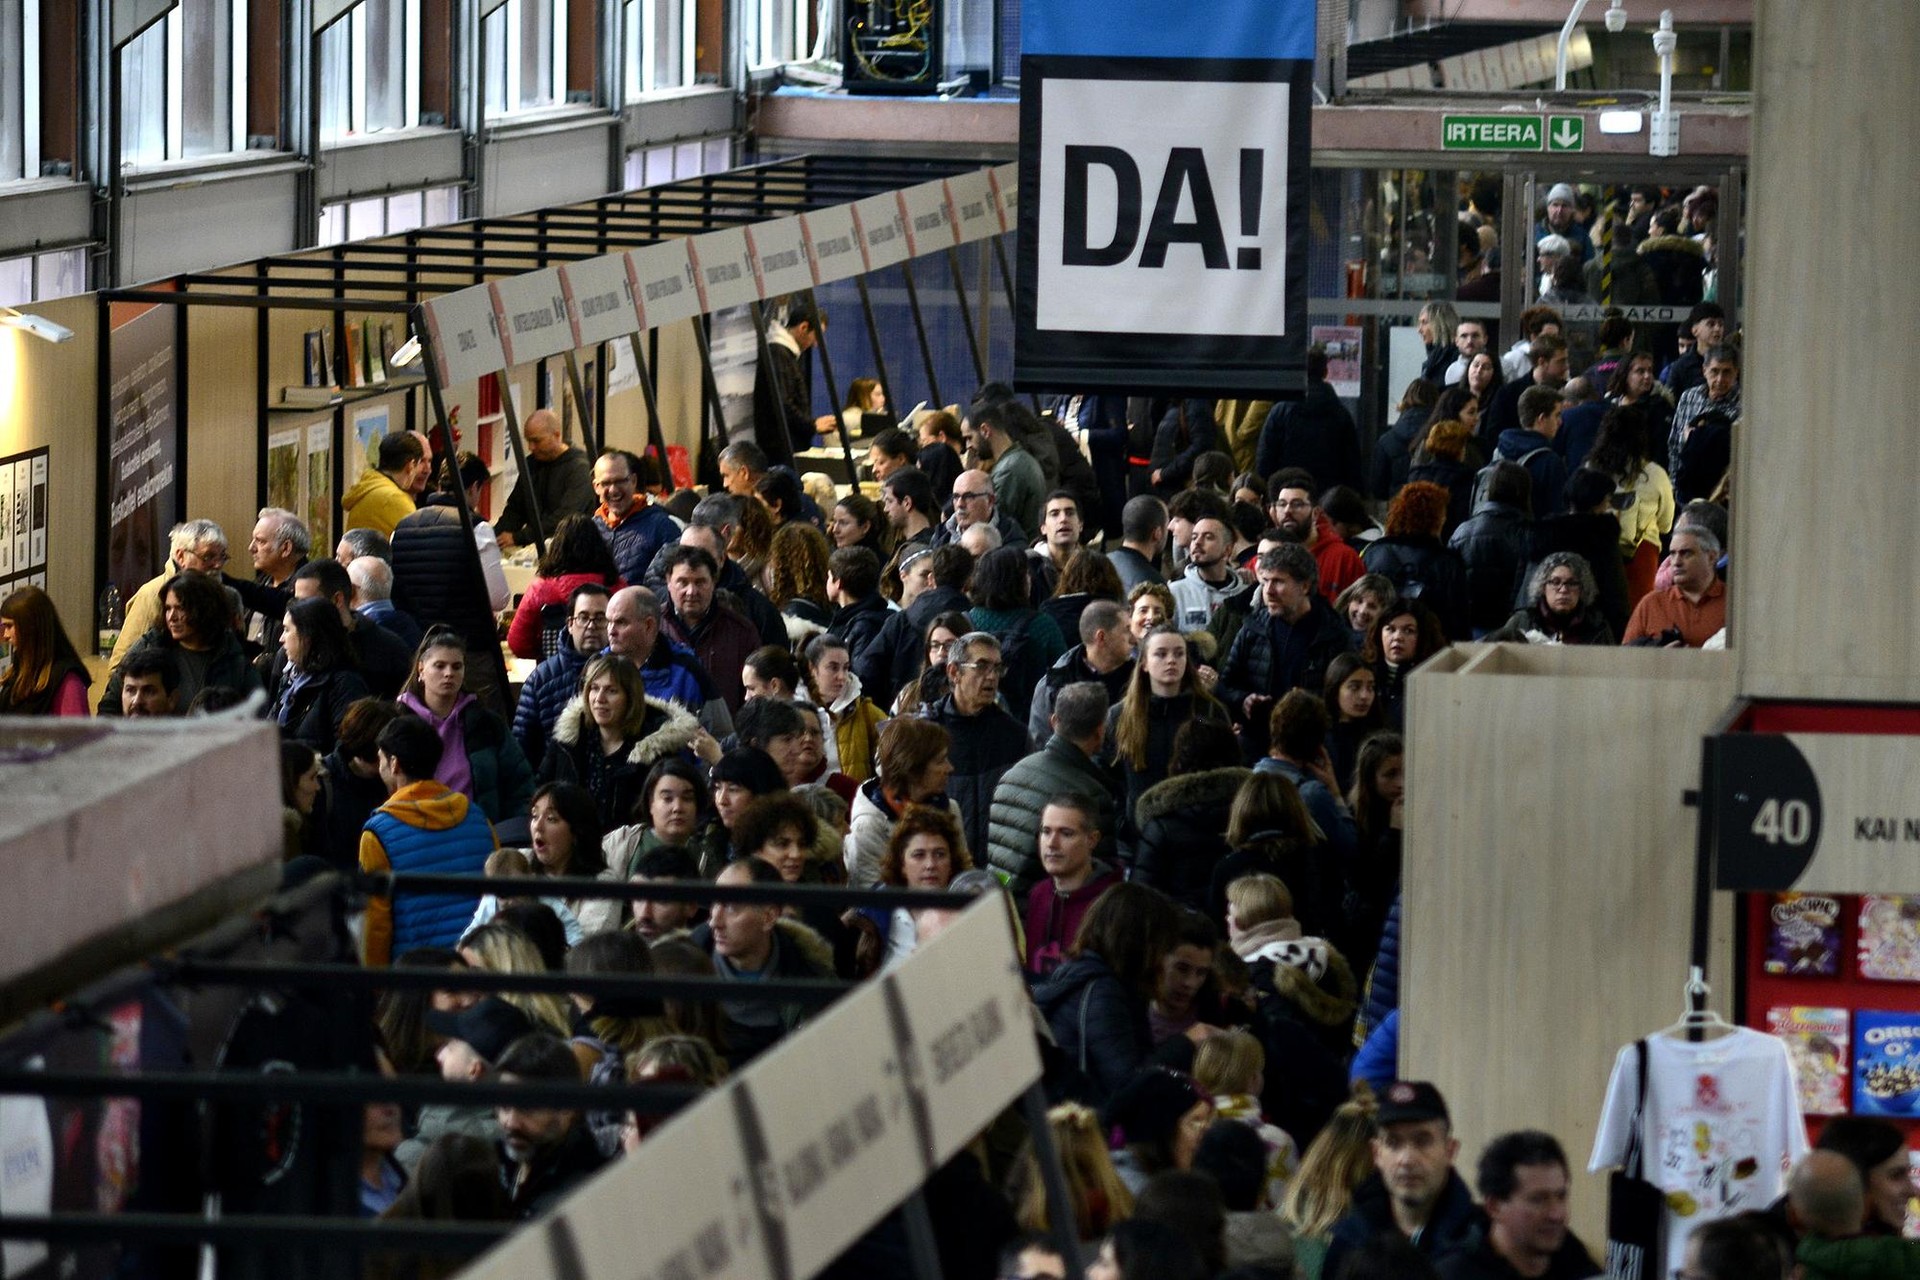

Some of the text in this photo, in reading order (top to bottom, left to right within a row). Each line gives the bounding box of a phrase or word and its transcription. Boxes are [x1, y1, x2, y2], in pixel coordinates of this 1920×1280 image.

[1447, 123, 1537, 142] IRTEERA
[1062, 144, 1265, 270] DA!
[1563, 306, 1674, 320] LANAKO
[1752, 799, 1811, 844] 40
[1854, 816, 1897, 842] KAI
